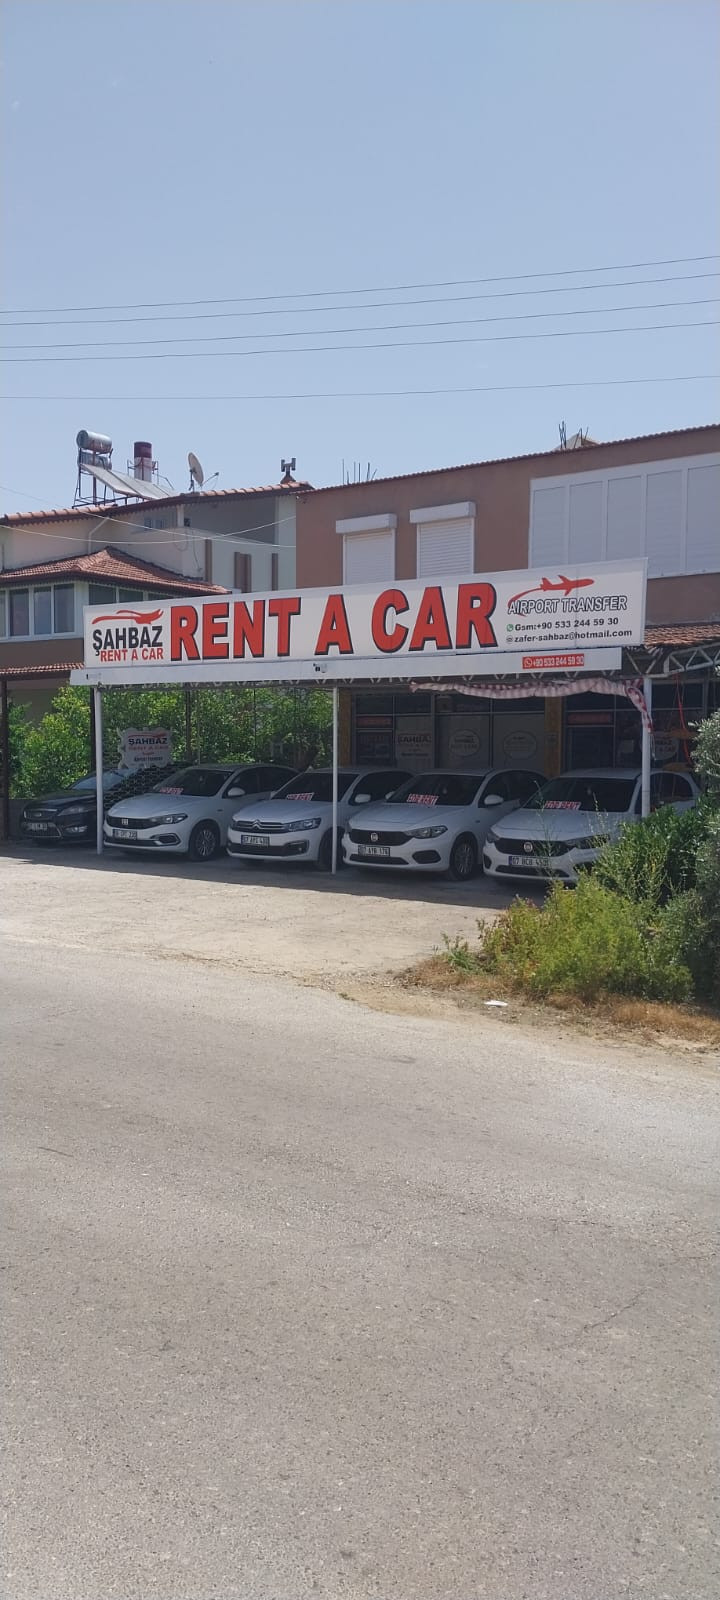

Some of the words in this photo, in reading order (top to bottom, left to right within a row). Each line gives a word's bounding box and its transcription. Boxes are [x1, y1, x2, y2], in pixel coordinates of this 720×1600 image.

[508, 599, 560, 615] AIRPORT
[560, 595, 628, 613] TRANSFER
[170, 597, 301, 661] RENT
[314, 594, 354, 655] A
[371, 582, 498, 653] CAR
[555, 620, 571, 629] 533
[574, 618, 590, 628] 244
[593, 617, 604, 626] 59
[607, 617, 619, 625] 30
[92, 625, 163, 656] ŞAHBAZ
[514, 630, 632, 643] zafer-sahbaz@hotmail.com
[100, 649, 128, 662] RENT
[131, 648, 138, 661] A
[141, 647, 164, 660] CAR
